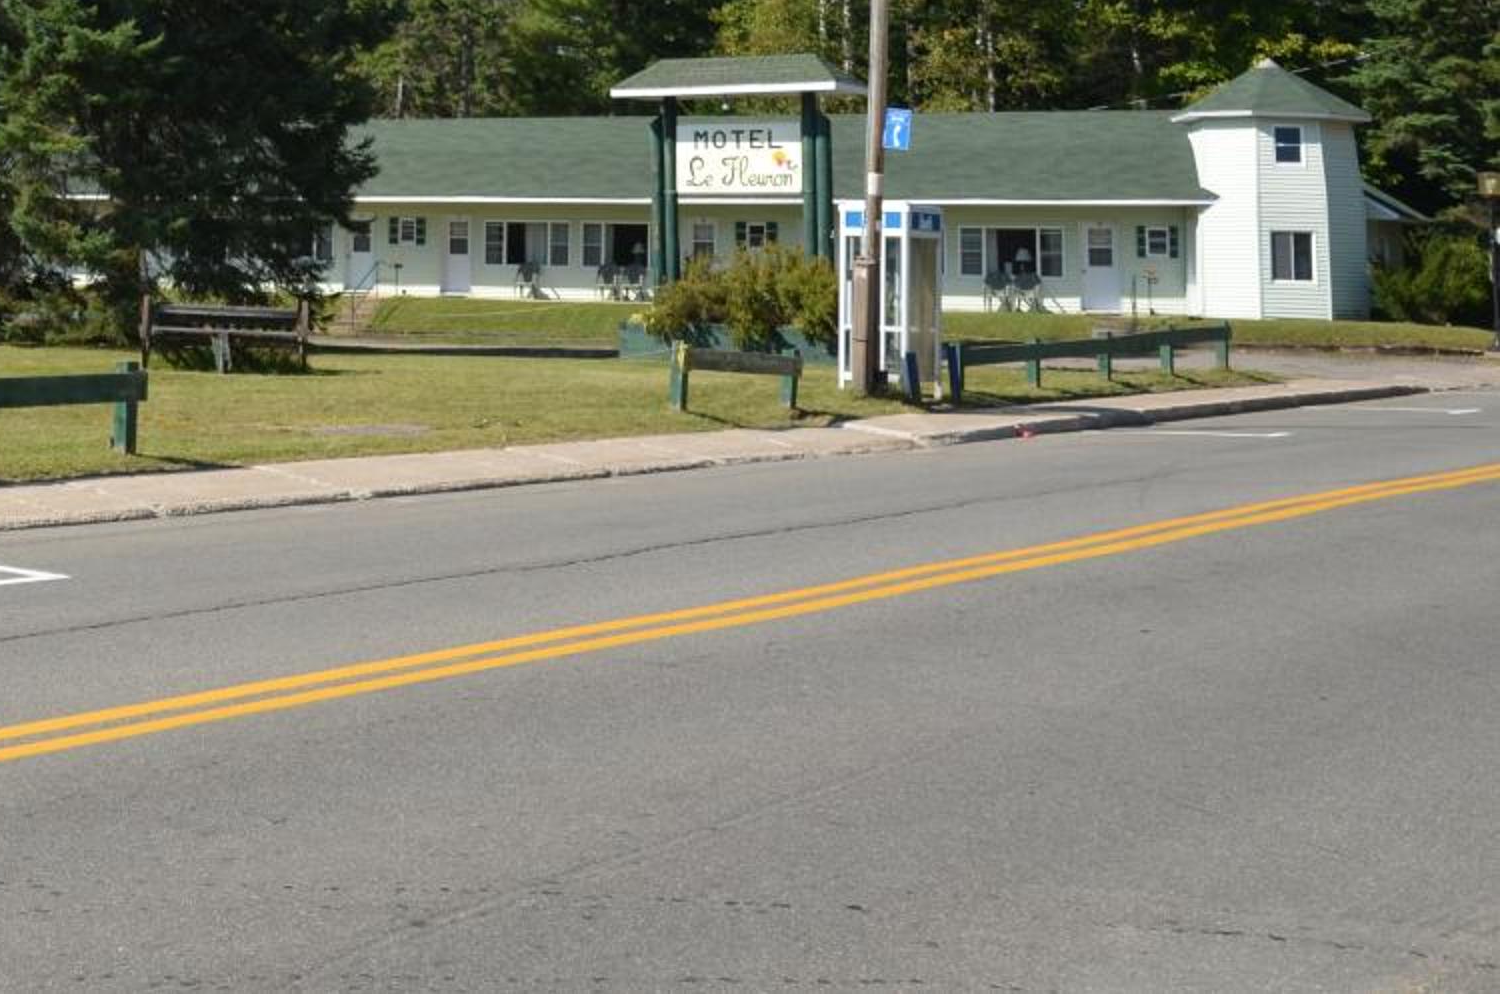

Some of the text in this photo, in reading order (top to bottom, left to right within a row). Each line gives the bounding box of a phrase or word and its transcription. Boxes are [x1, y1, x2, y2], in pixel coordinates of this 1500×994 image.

[693, 129, 783, 150] MOTEL
[686, 156, 793, 187] Le Fleuron
